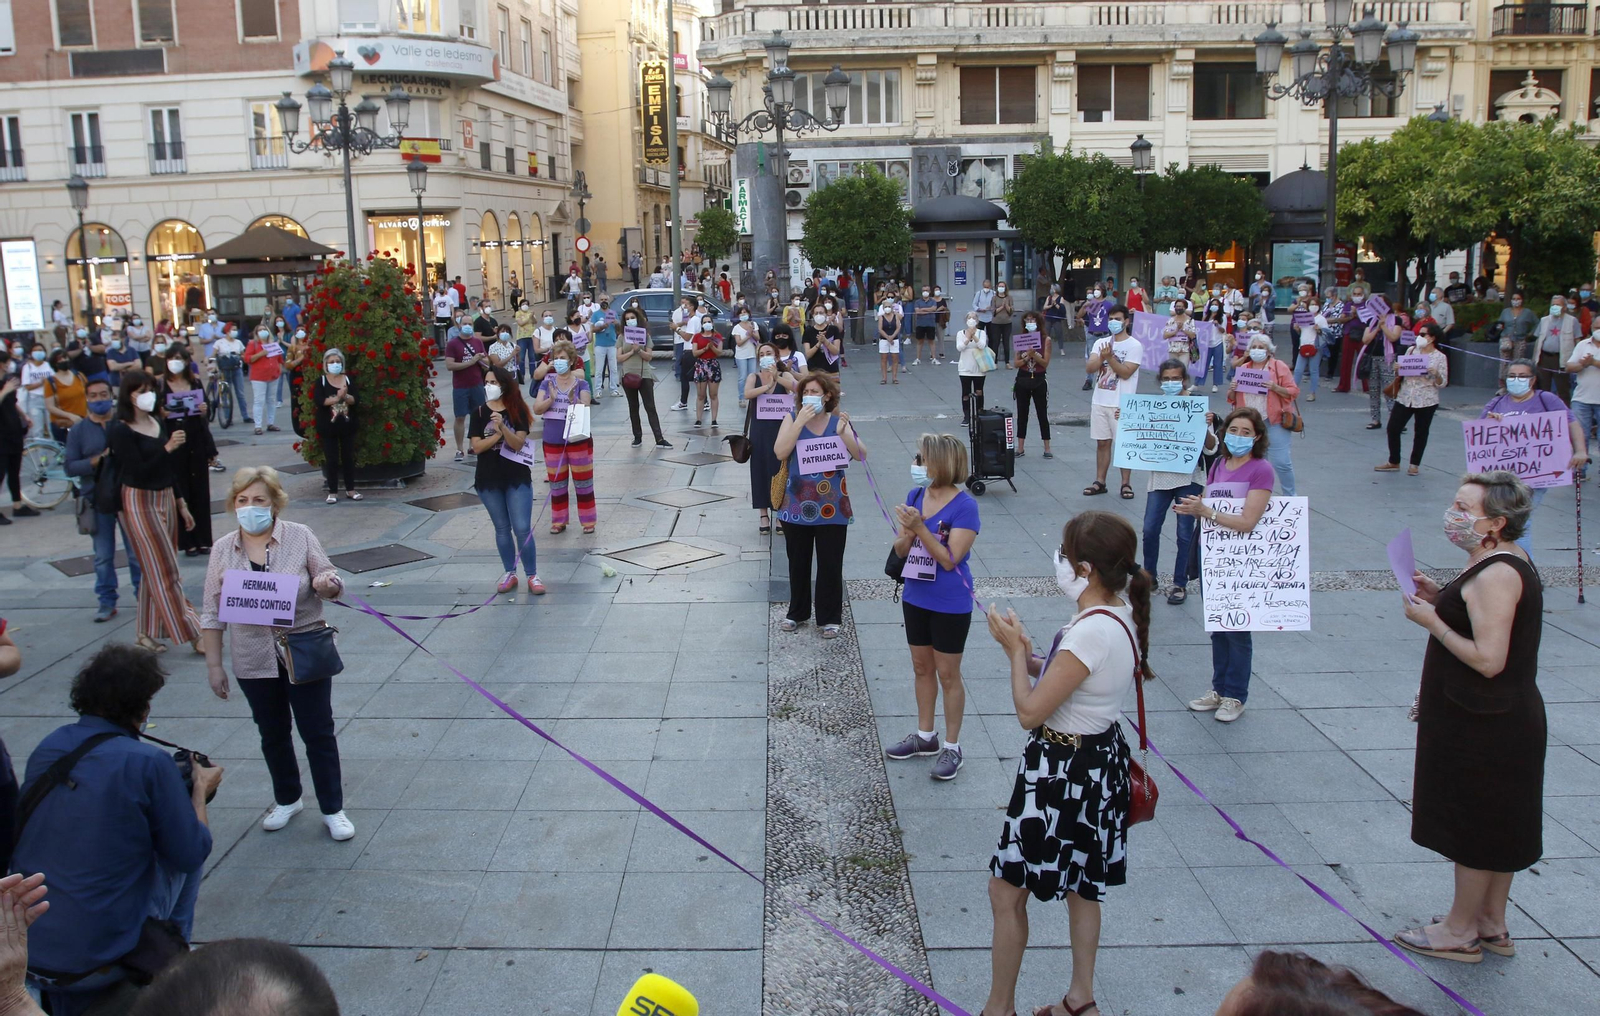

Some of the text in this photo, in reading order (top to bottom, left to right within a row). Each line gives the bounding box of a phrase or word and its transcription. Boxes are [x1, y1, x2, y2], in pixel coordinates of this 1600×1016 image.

[392, 44, 422, 57] Valle
[425, 46, 440, 58] de
[648, 85, 663, 145] EMFISA
[738, 180, 748, 233] FARMACIA
[378, 221, 408, 229] ALVARO
[422, 219, 450, 227] ORENO
[1240, 372, 1263, 380] JUSTICIA
[1126, 399, 1205, 413] HASTA LOS OVARIOS
[1138, 413, 1145, 421] LA
[1148, 412, 1180, 421] JUSTICIA
[1187, 414, 1193, 423] Y
[1136, 431, 1195, 441] PATRIARCALES
[1465, 416, 1562, 449] ¡HERMANA!
[805, 442, 838, 452] JUSTICIA
[1501, 442, 1530, 459] ESTÁ
[1533, 444, 1553, 458] TU
[802, 453, 845, 464] PATRIARCAL
[1481, 460, 1541, 475] MANADA!
[1278, 501, 1290, 516] Y
[1258, 517, 1280, 527] QUE
[1248, 530, 1263, 540] ES
[1269, 527, 1290, 541] NO
[1205, 545, 1213, 556] Y
[1229, 543, 1264, 556] LLEVAS
[1268, 543, 1301, 558] FALDA
[908, 554, 934, 567] CONTIGO
[1204, 558, 1213, 566] E
[1215, 557, 1243, 568] IBAS
[1249, 569, 1266, 578] ES
[1270, 568, 1292, 580] NO
[242, 579, 278, 594] HERMANA,
[1205, 579, 1212, 591] Y
[226, 596, 292, 611] ESTAMOS CONTIGO
[1206, 591, 1274, 603] HACERTE A TI
[1251, 602, 1260, 610] LA
[1265, 600, 1309, 609] RESPUESTA
[1208, 611, 1246, 627] ES NO
